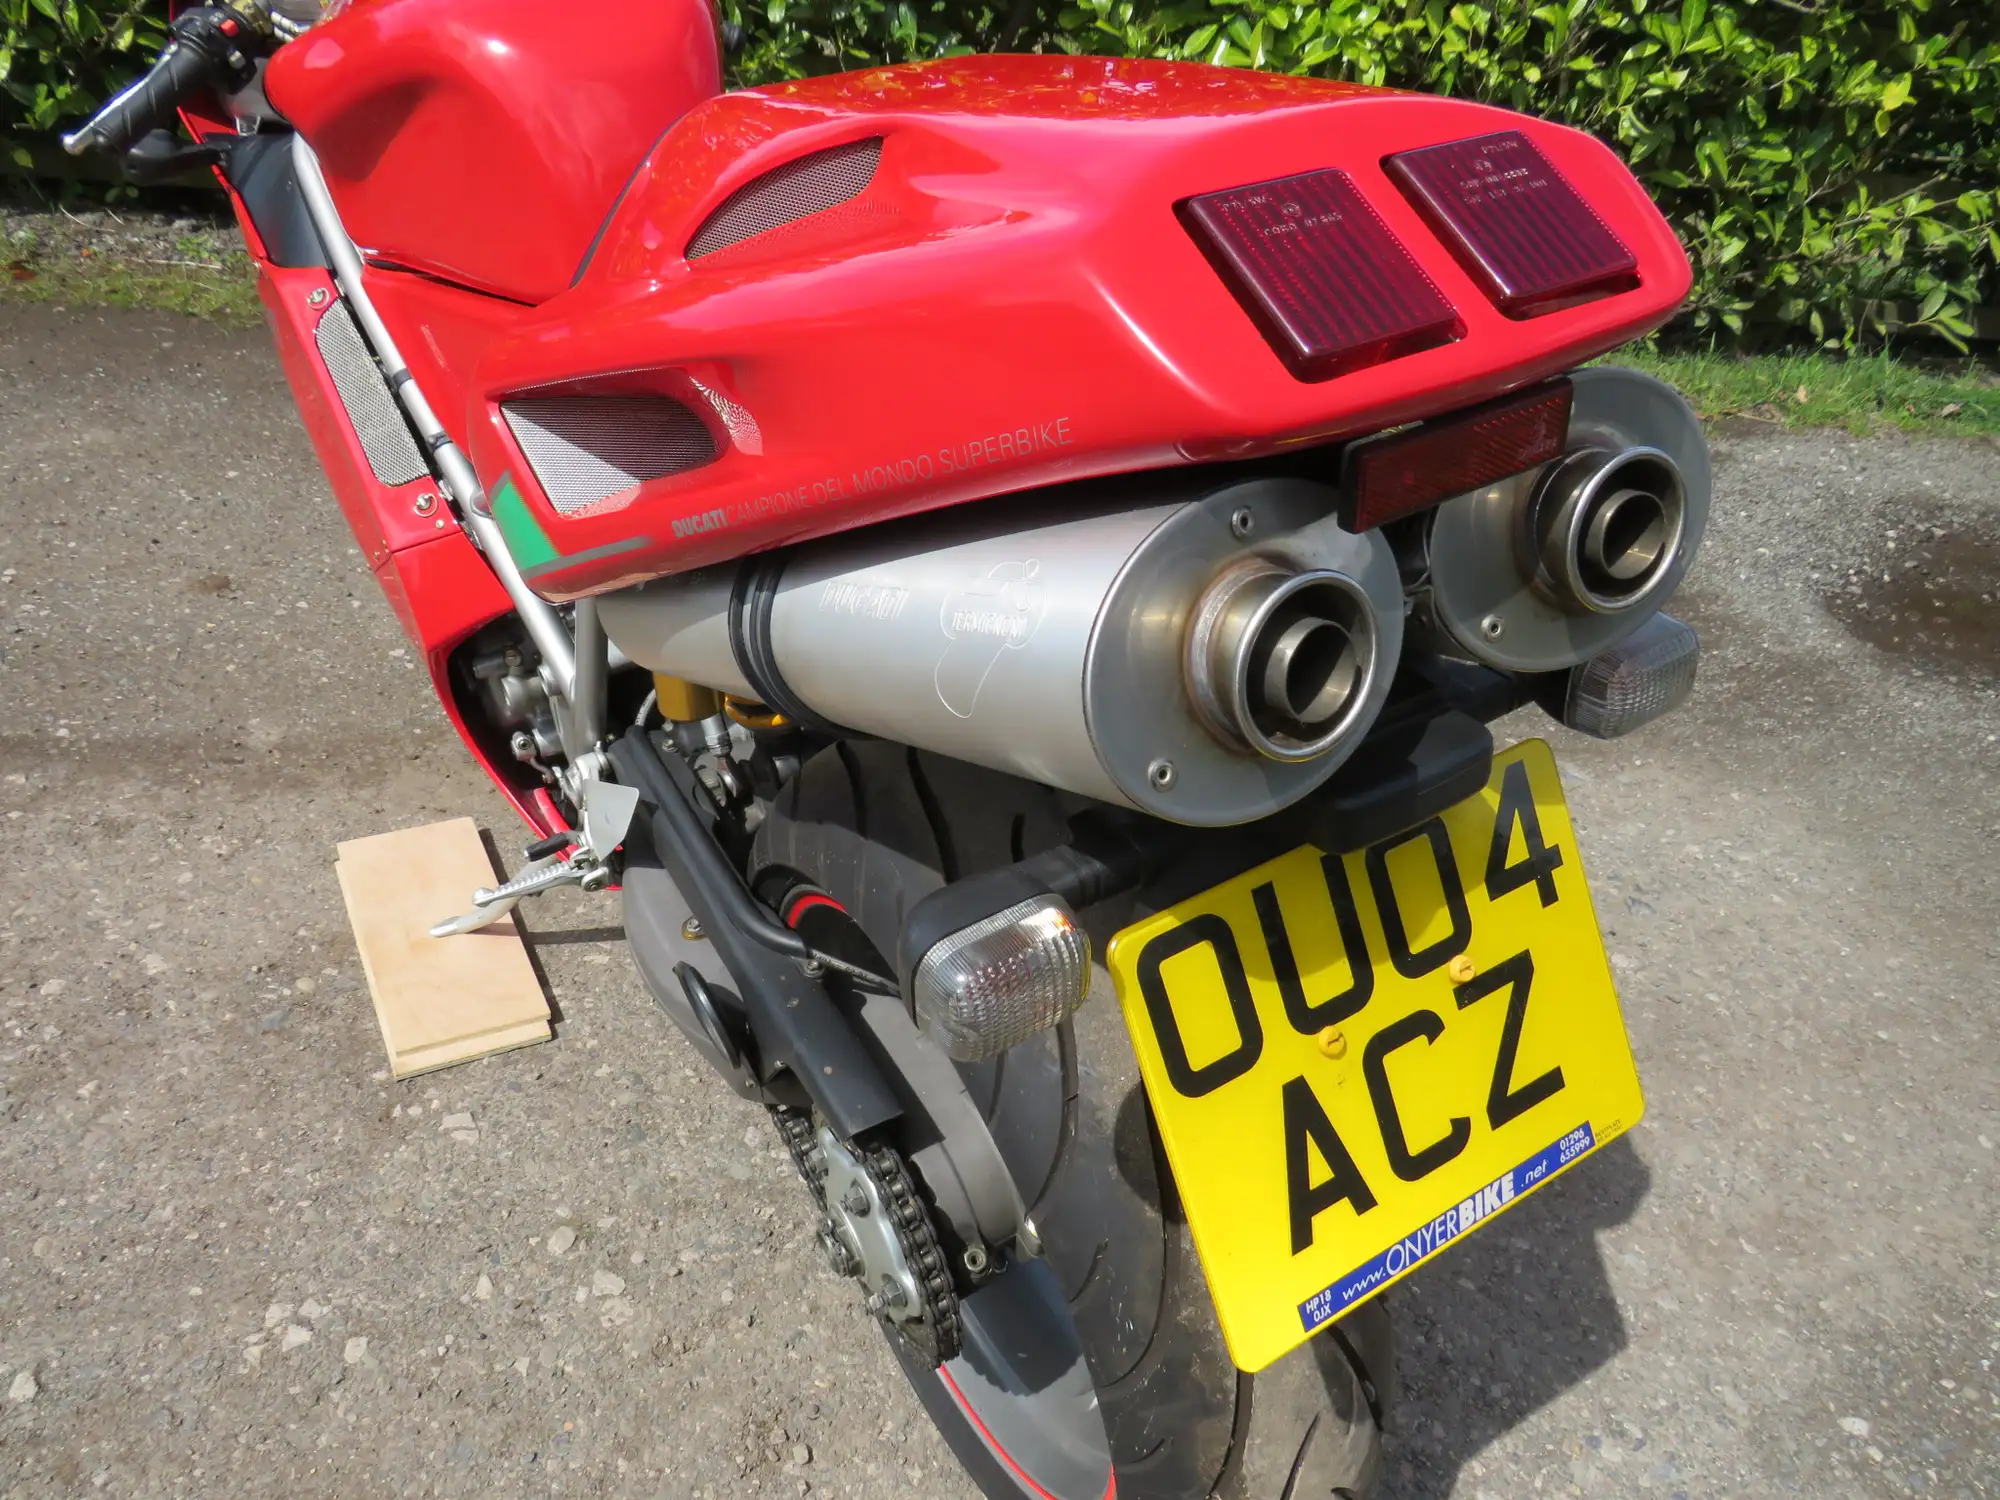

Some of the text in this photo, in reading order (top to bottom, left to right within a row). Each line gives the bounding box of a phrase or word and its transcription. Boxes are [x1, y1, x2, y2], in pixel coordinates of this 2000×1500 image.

[672, 417, 1073, 538] DUCATI CAMPIONE DEL MONDO SUPERBIKE
[1137, 759, 1564, 1098] OU04
[1282, 948, 1566, 1256] ACZ
[1560, 1127, 1585, 1150] 01296
[1560, 1136, 1590, 1163] 655999
[1306, 1289, 1332, 1314] HP18
